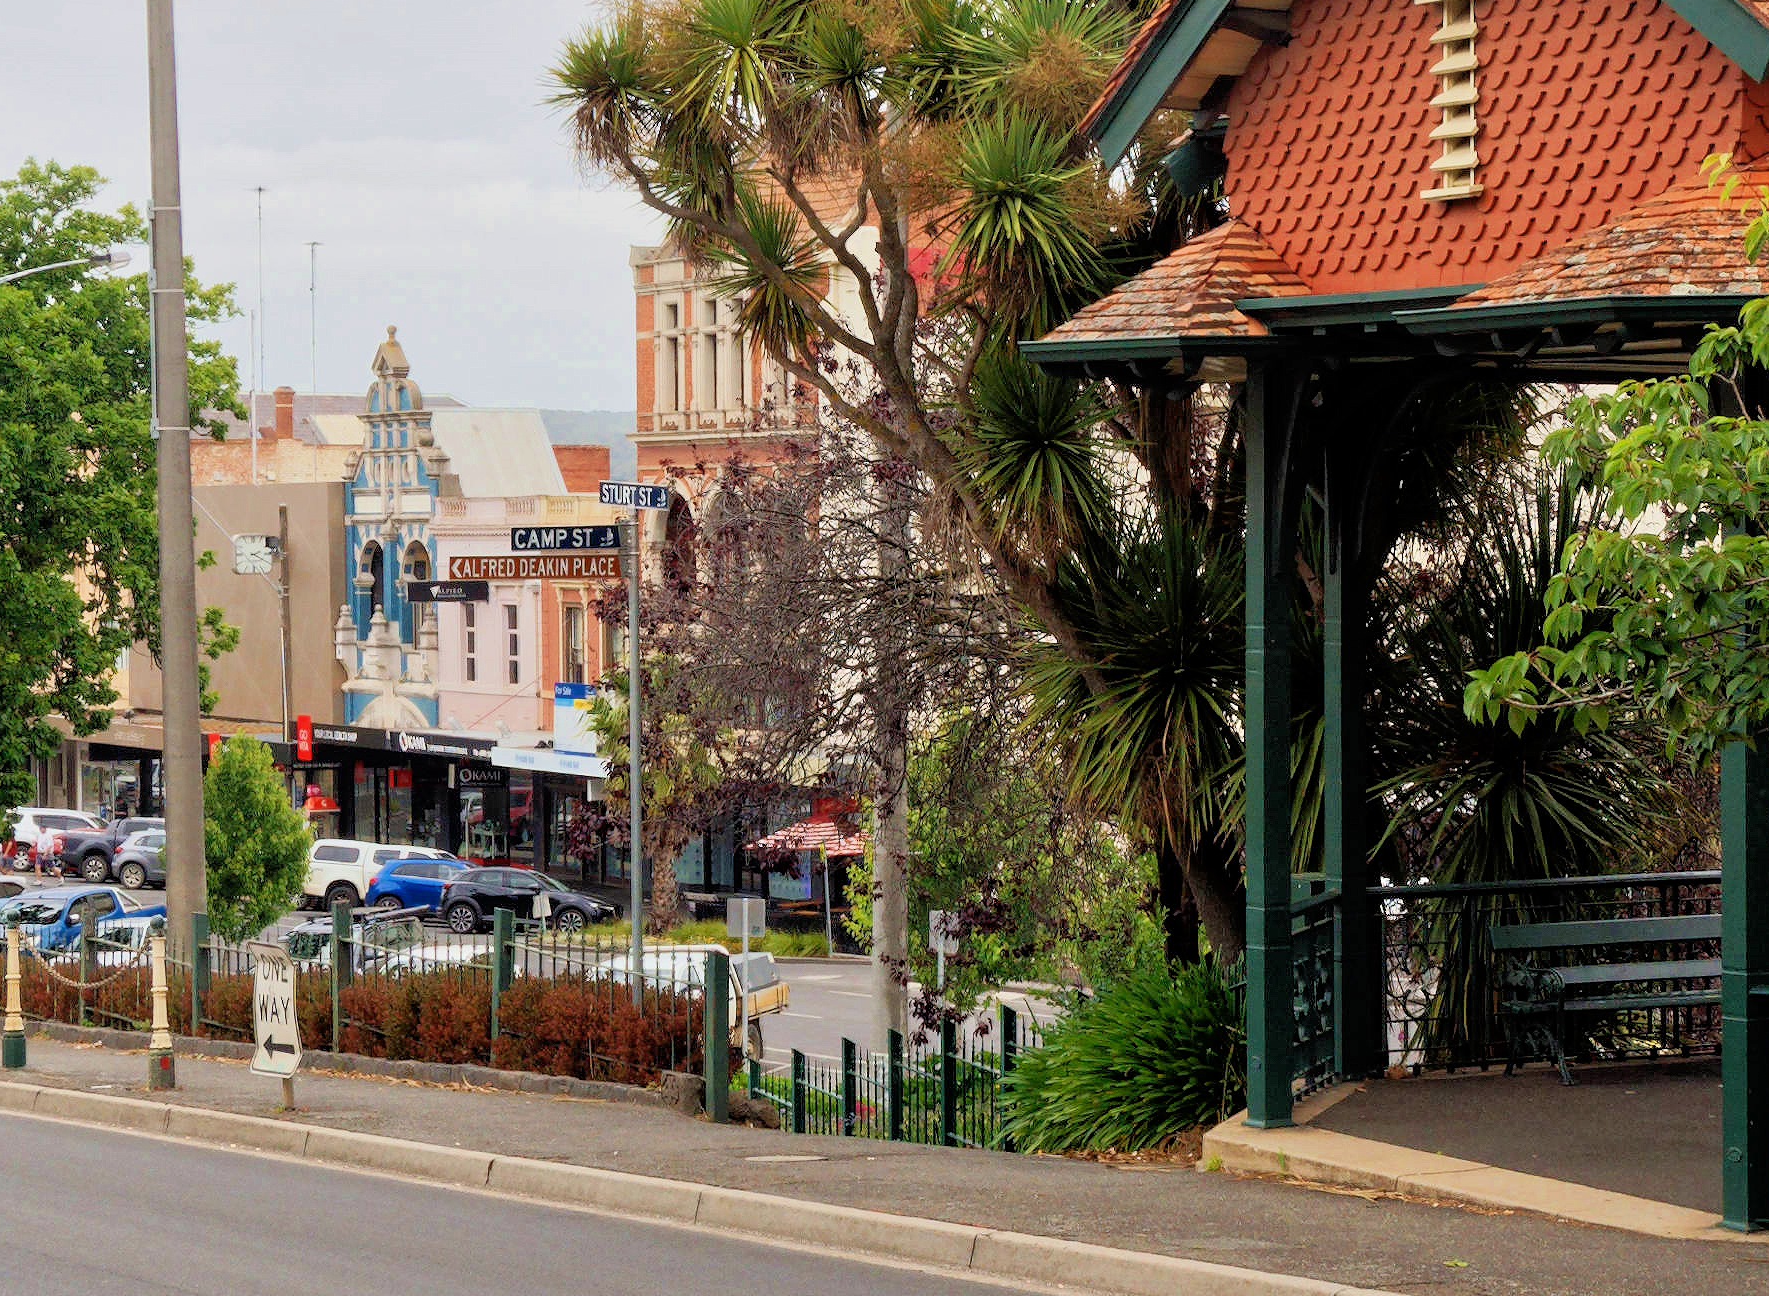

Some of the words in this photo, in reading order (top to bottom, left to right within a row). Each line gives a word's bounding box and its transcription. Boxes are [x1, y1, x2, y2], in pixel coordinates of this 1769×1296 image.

[601, 484, 637, 504] STURT
[639, 487, 653, 506] ST
[514, 529, 568, 550] CAMP
[571, 528, 593, 548] ST
[462, 558, 516, 578] ALFRED
[519, 558, 570, 578] DEAKIN
[572, 557, 615, 577] PLACE
[459, 768, 502, 784] OKAMI
[260, 953, 289, 983] ONE
[258, 993, 290, 1025] WAY
